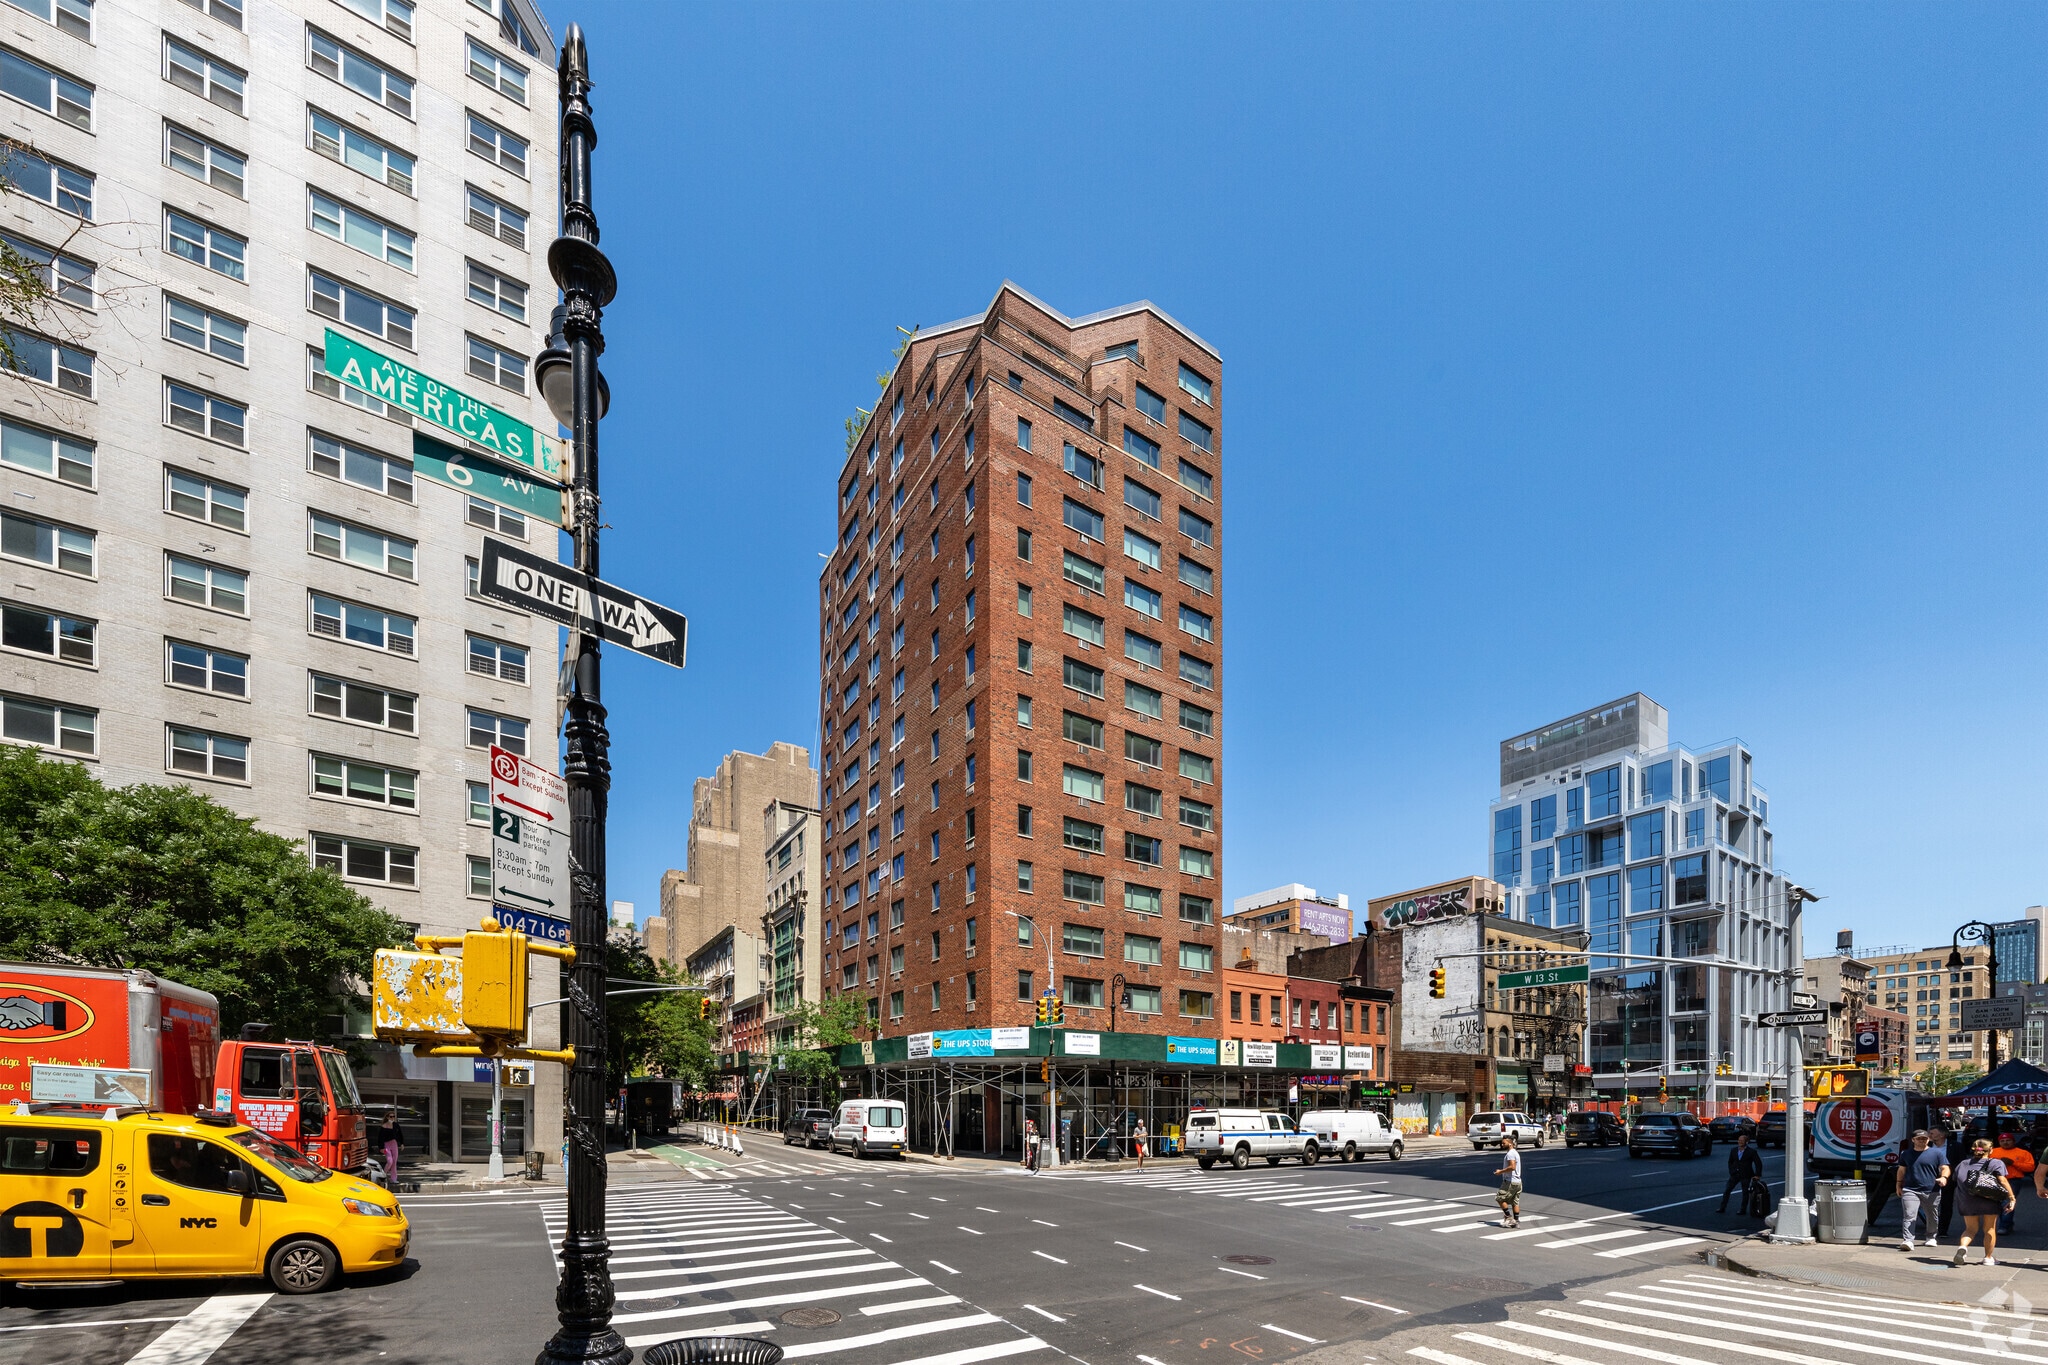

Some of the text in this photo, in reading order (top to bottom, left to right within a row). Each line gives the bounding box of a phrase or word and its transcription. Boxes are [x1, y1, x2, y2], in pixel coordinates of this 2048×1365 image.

[381, 359, 489, 420] AVE OF THE
[341, 357, 523, 457] AMERICAS
[445, 453, 474, 486] 6
[488, 591, 504, 600] DEPT
[522, 603, 571, 624] TRANSPORTATION
[515, 568, 658, 639] ONE WAY
[521, 777, 566, 805] Except Sunday
[522, 766, 536, 780] 8am
[542, 775, 564, 793] 8:30am
[500, 812, 514, 840] 2
[523, 823, 538, 833] hour
[523, 832, 551, 847] metered
[497, 847, 527, 866] 8:30am
[535, 860, 550, 874] 7pm
[523, 841, 548, 856] parking
[497, 859, 555, 887] Except Sunday
[495, 910, 557, 939] 104716
[1303, 909, 1318, 920] RENT
[1332, 913, 1346, 924] NOW
[1524, 973, 1558, 984] W 13 St
[1767, 1014, 1819, 1024] ONE WAY
[943, 1040, 956, 1049] THE
[957, 1039, 971, 1048] UPS
[972, 1038, 993, 1047] STORE
[0, 1056, 20, 1068] iga
[1963, 1095, 2016, 1106] COVID-19
[1840, 1109, 1882, 1120] COVD-19
[180, 1218, 217, 1228] NYC
[14, 1216, 63, 1258] T
